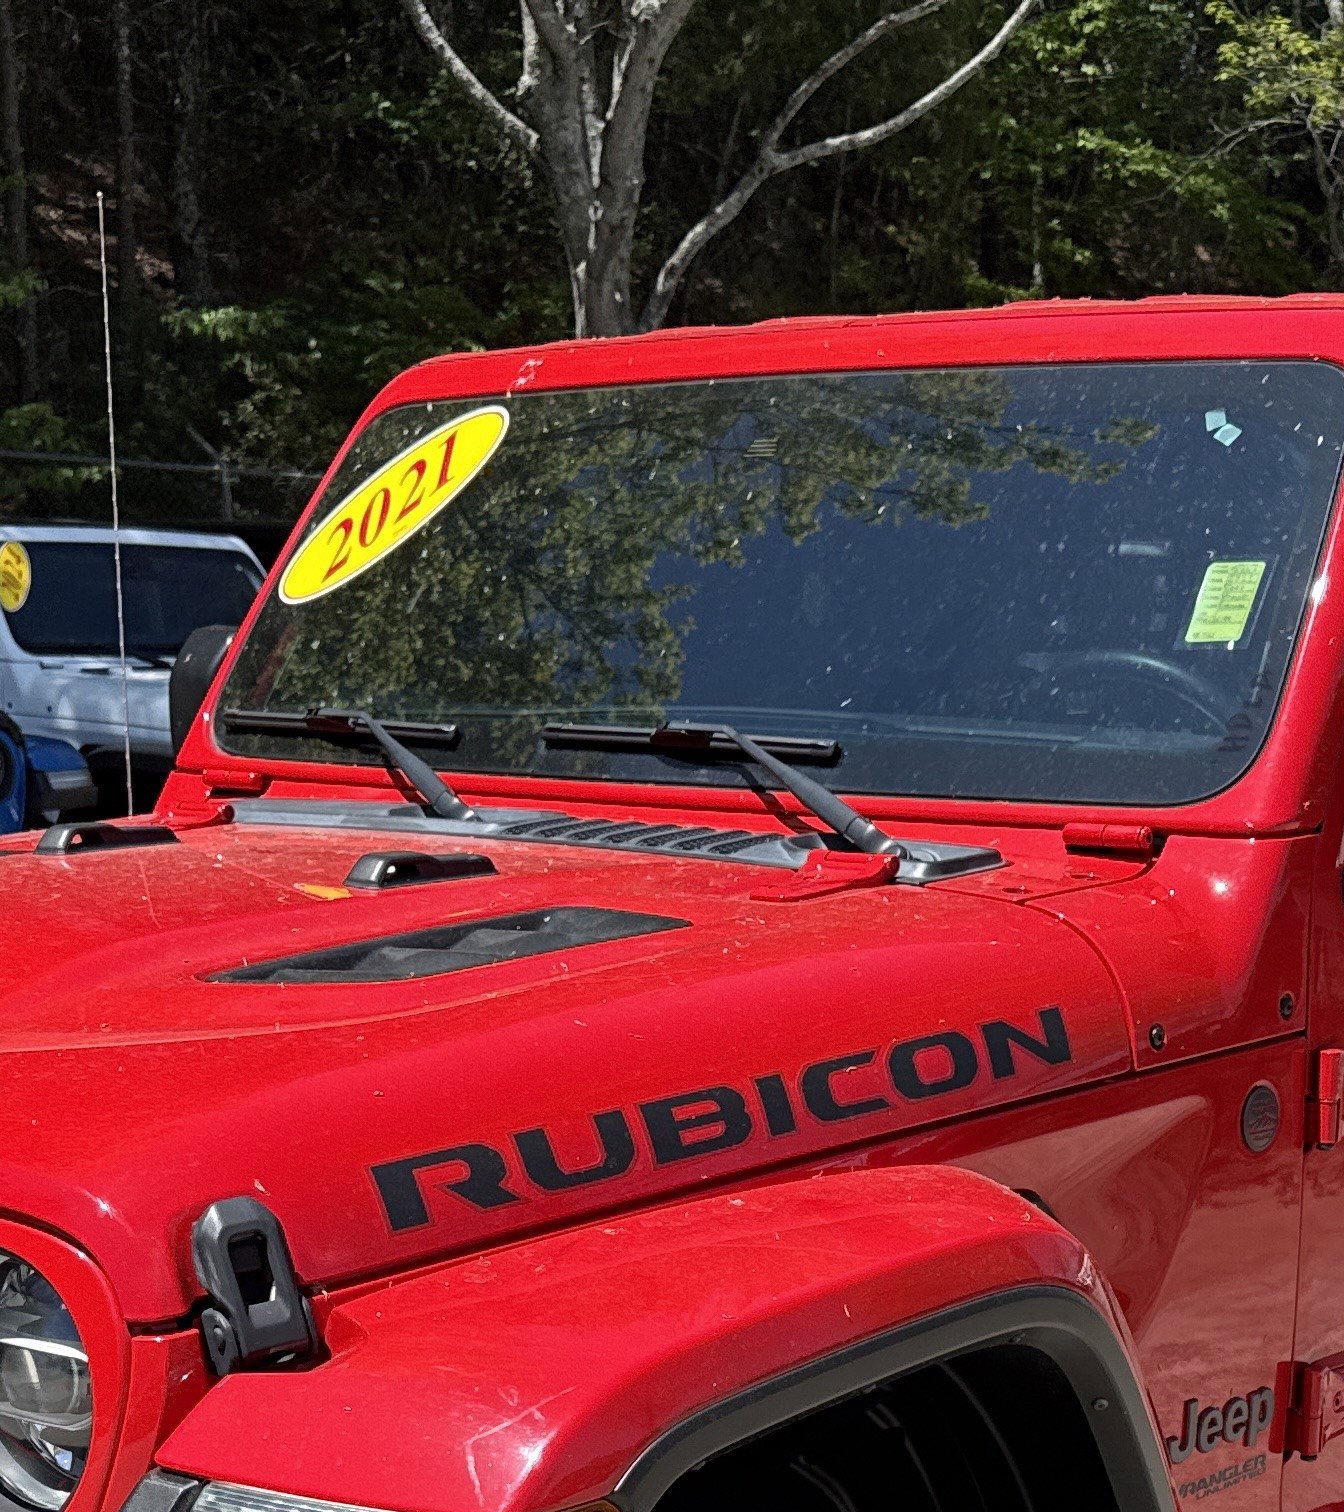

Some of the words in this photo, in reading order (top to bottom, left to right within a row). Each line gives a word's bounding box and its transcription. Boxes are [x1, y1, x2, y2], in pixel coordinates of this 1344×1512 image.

[321, 429, 459, 584] 2021
[370, 1006, 1072, 1232] RUBICON
[1166, 1386, 1275, 1464] Jeep
